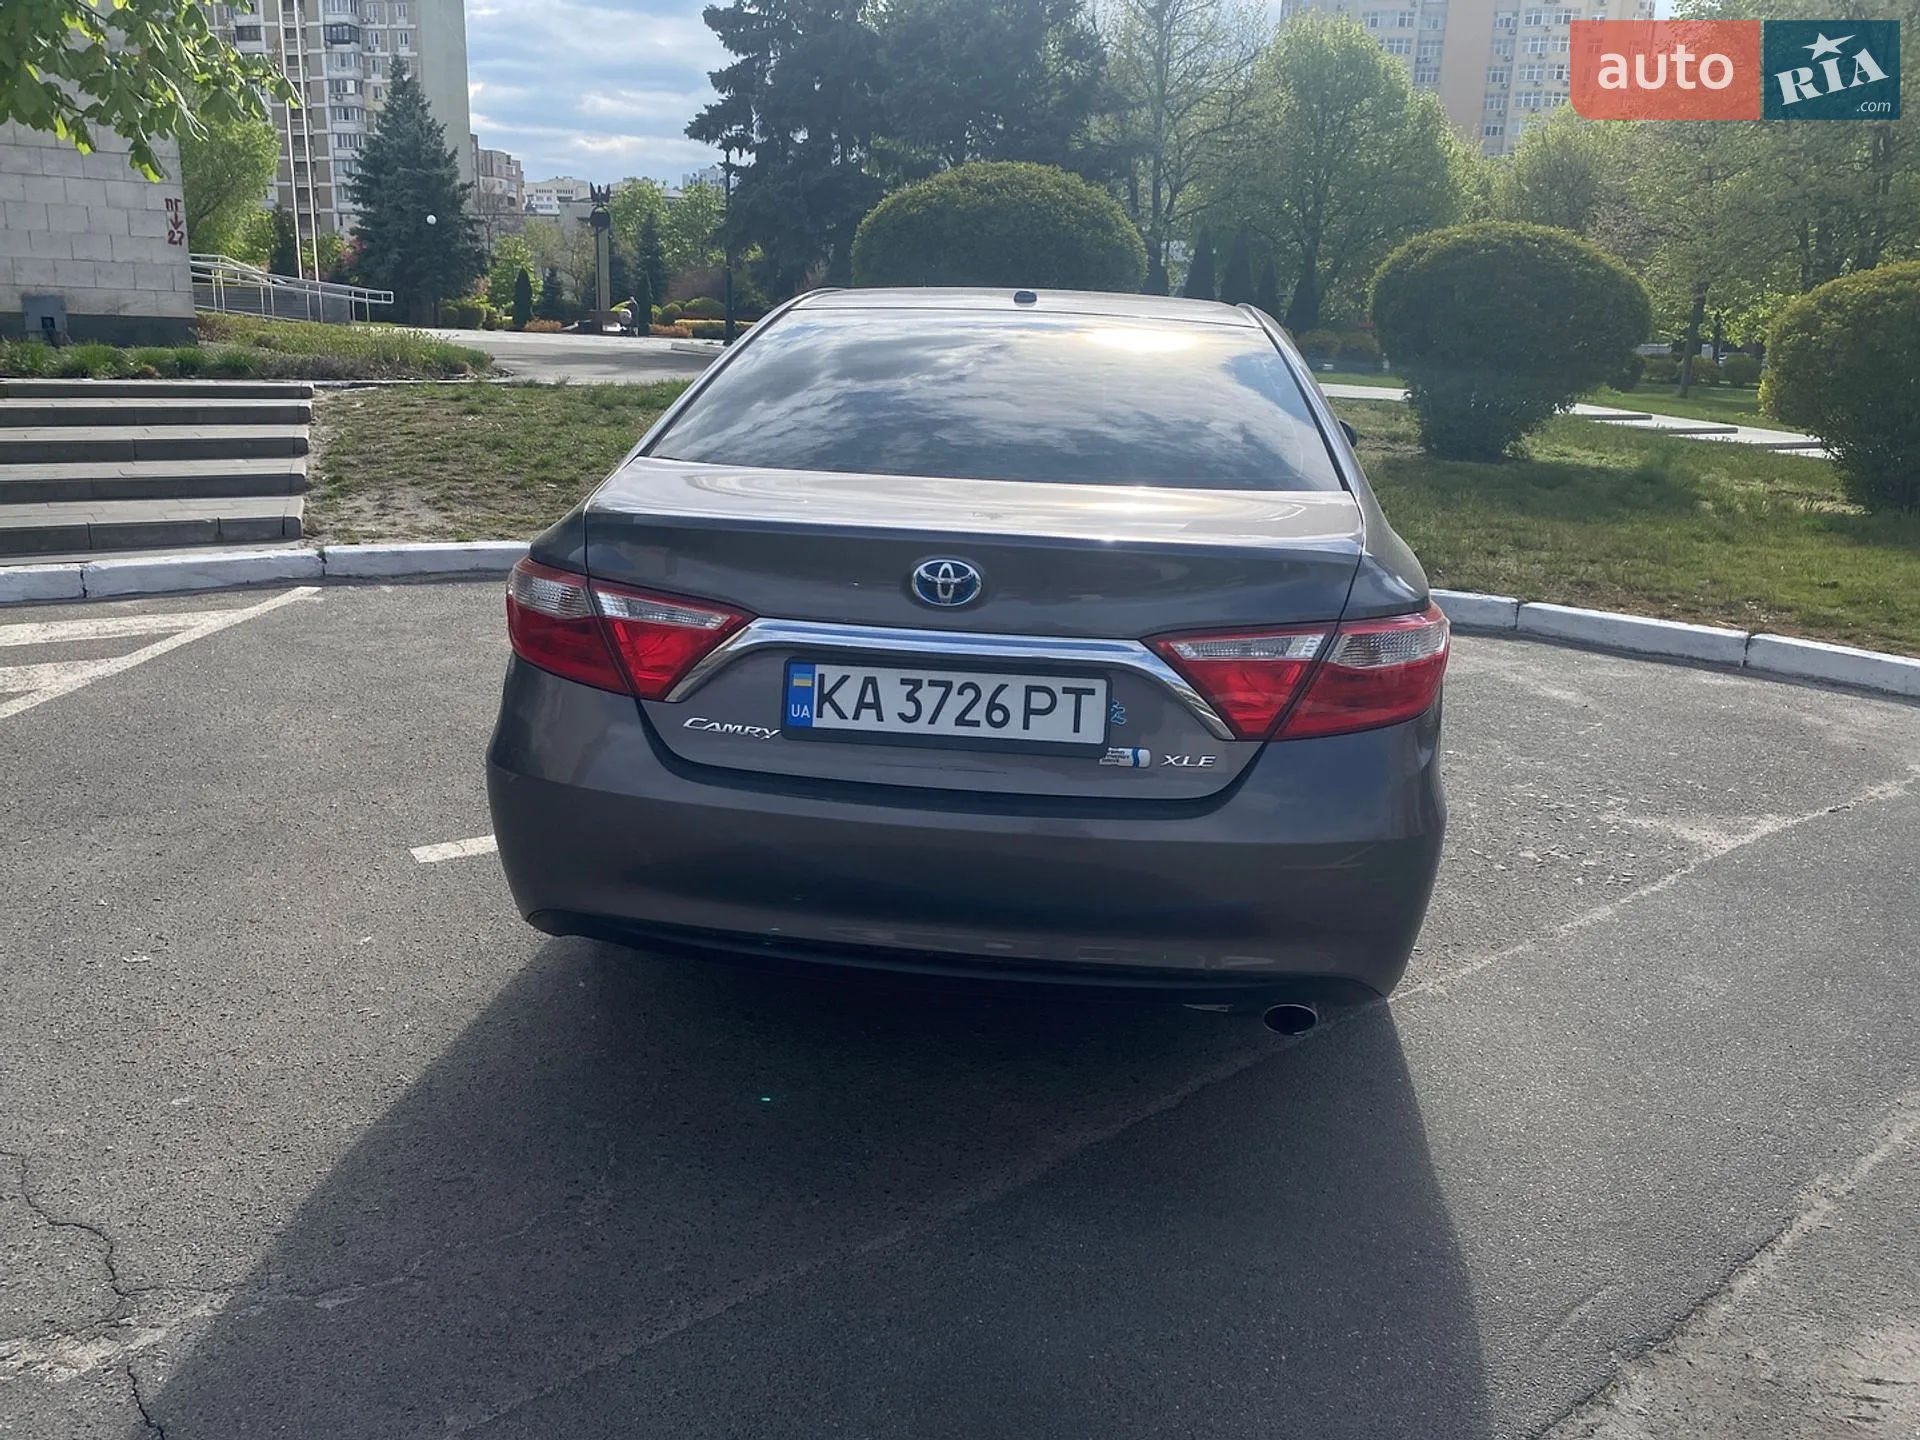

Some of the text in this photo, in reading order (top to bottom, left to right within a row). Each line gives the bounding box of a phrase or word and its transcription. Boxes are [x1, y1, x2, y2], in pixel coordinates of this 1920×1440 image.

[168, 230, 185, 246] 27
[791, 704, 811, 718] UA
[816, 673, 1096, 734] KA 3726 PT
[683, 717, 781, 740] CAMRY
[1161, 754, 1217, 768] XLE
